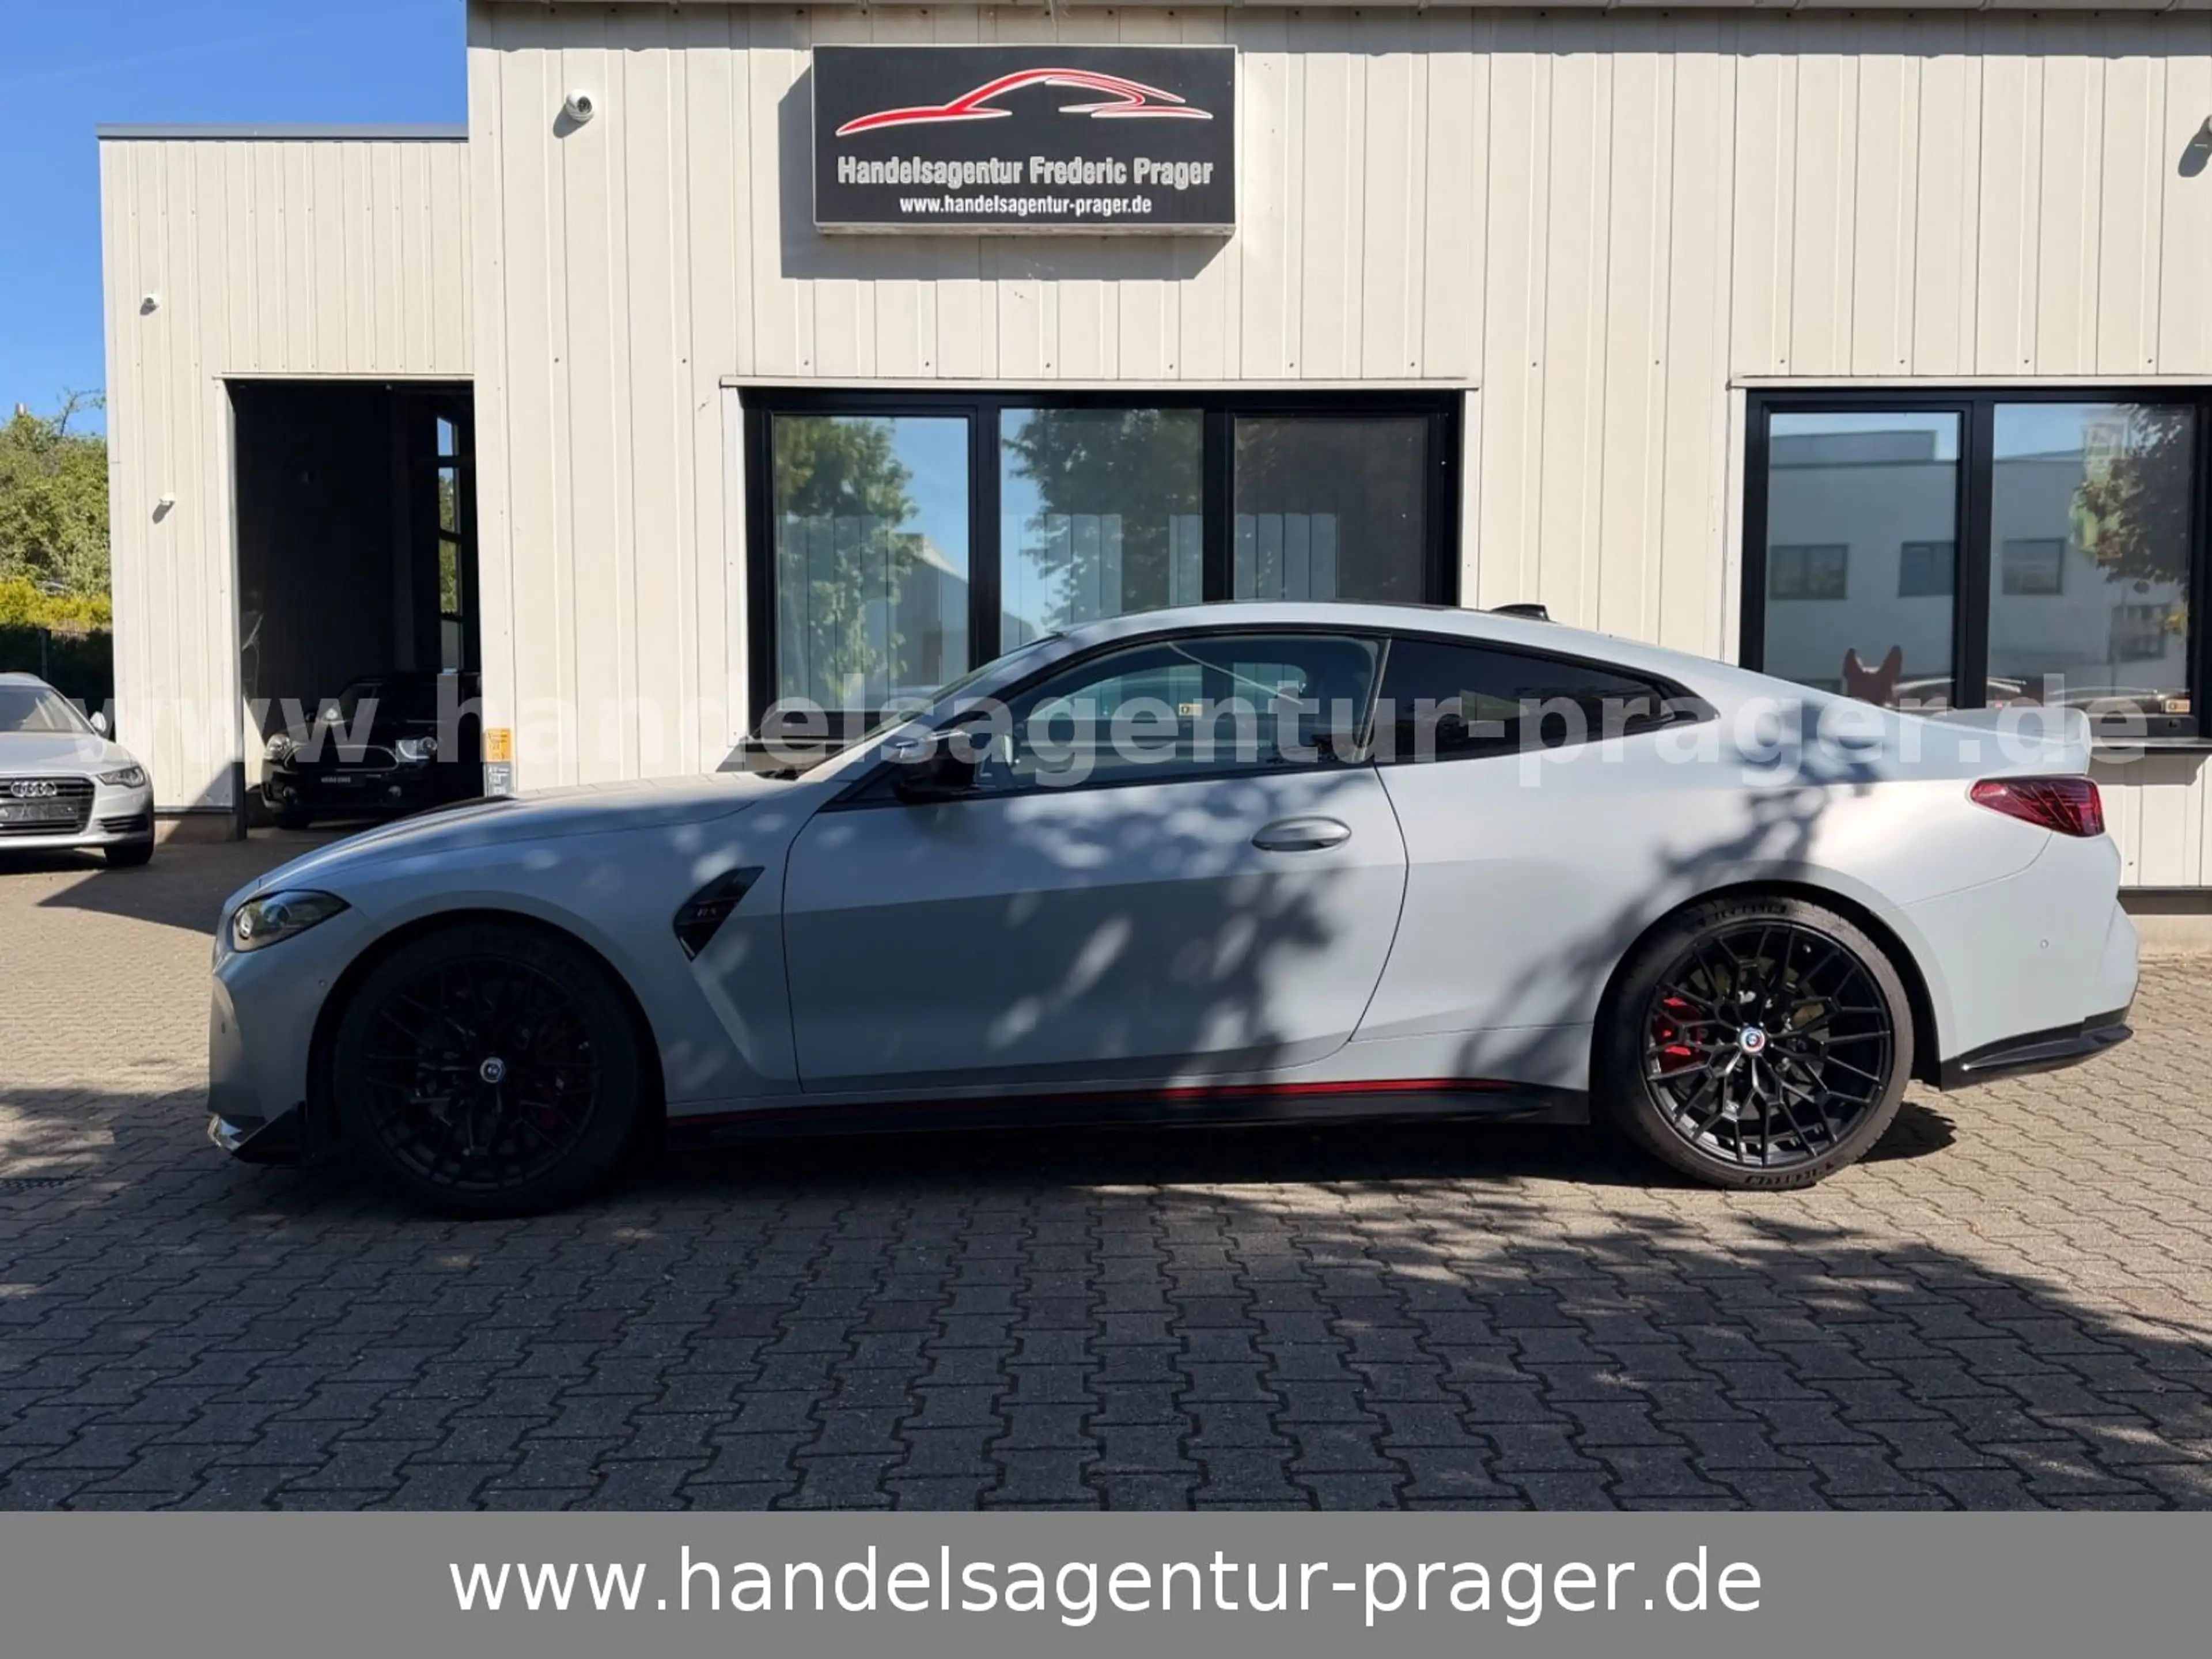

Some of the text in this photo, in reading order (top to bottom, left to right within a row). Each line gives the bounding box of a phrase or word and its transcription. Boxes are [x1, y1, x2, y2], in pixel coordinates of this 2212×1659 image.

[838, 156, 1213, 190] Handelsagentur Frederic Prager
[900, 195, 1152, 217] www.handelsagentur-prager.de
